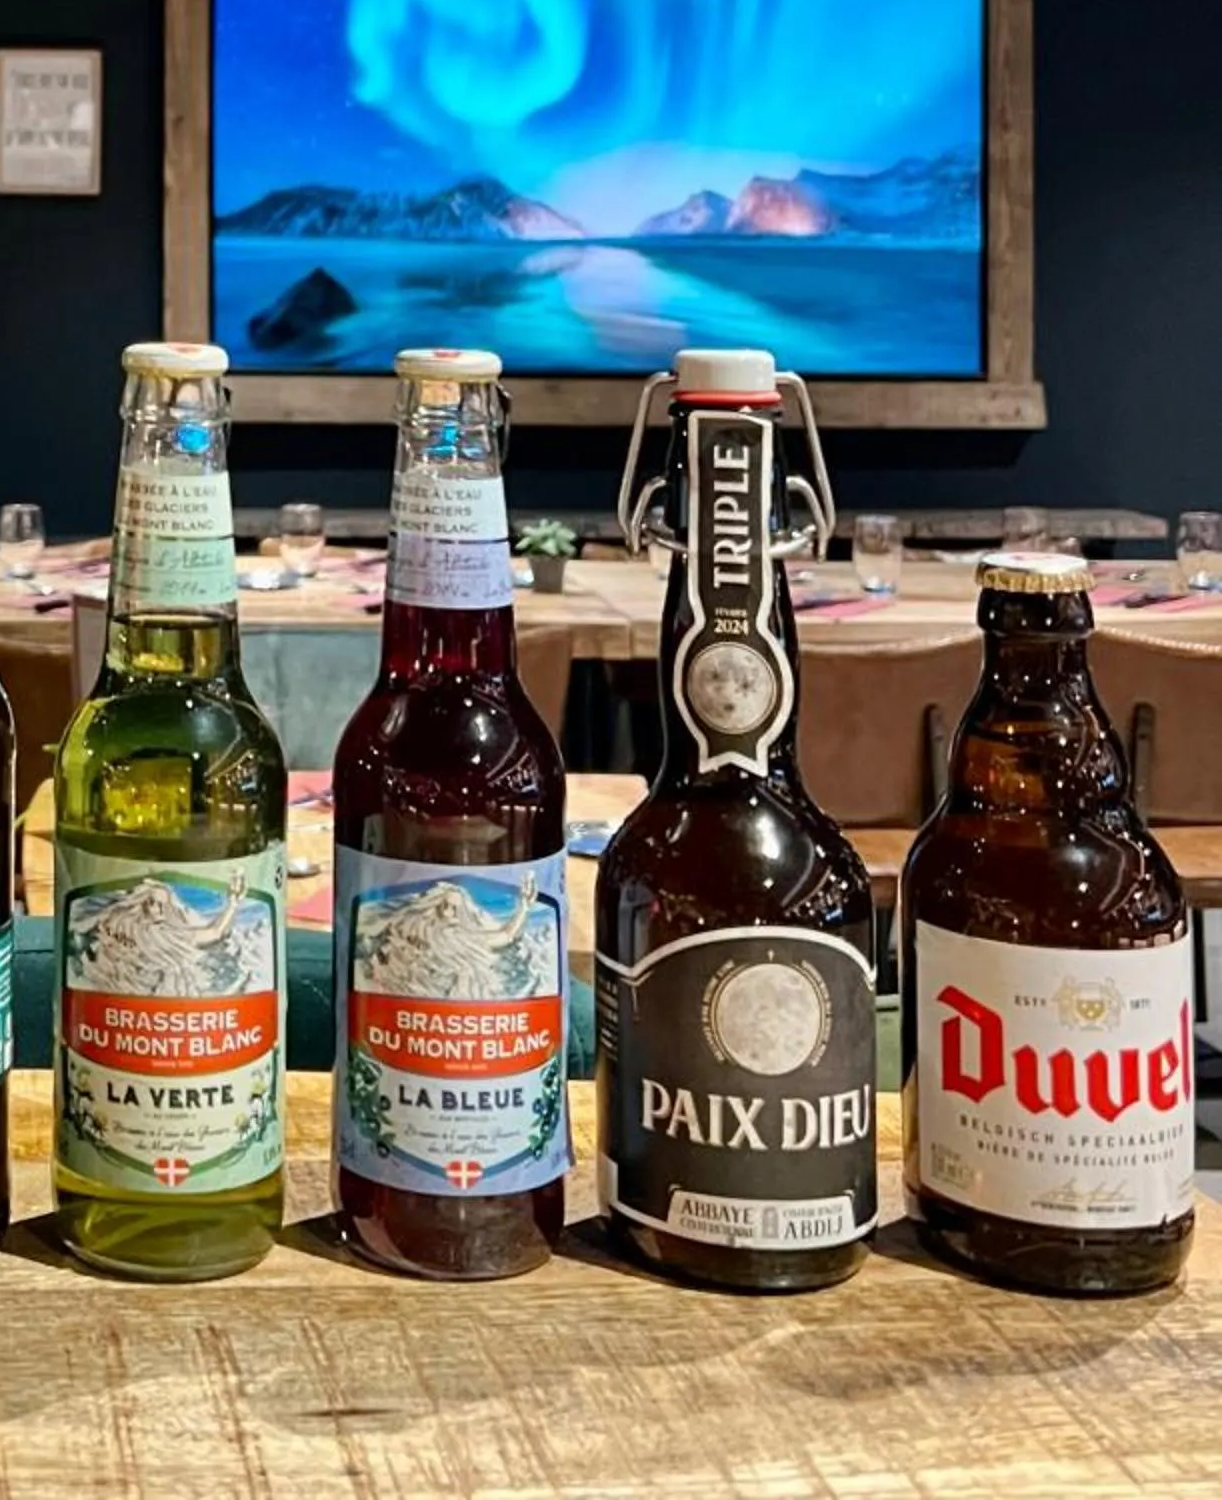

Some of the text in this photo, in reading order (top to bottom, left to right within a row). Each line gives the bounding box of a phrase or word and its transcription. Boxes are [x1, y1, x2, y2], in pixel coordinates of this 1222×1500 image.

[144, 501, 208, 513] GLACIERS
[409, 503, 472, 516] GLACIERS
[713, 443, 750, 588] TRIPLE
[172, 520, 215, 531] BLANC
[433, 522, 478, 534] BLANC
[713, 618, 748, 636] 2024
[105, 1008, 239, 1033] BRASSERIE
[397, 1011, 530, 1036] BRASSERIE
[79, 1022, 263, 1057] DU MONT BLANC
[369, 1026, 550, 1061] DU MONT BLANC
[936, 985, 1191, 1123] Duvel
[107, 1081, 234, 1109] LA VERTE
[399, 1084, 525, 1111] LA BLEUE
[642, 1079, 870, 1151] PAIX DIEU
[959, 1114, 1055, 1144] BELGISCH
[1027, 1152, 1045, 1164] DE
[681, 1199, 754, 1225] ABBAYE
[784, 1215, 843, 1240] ABDIJ
